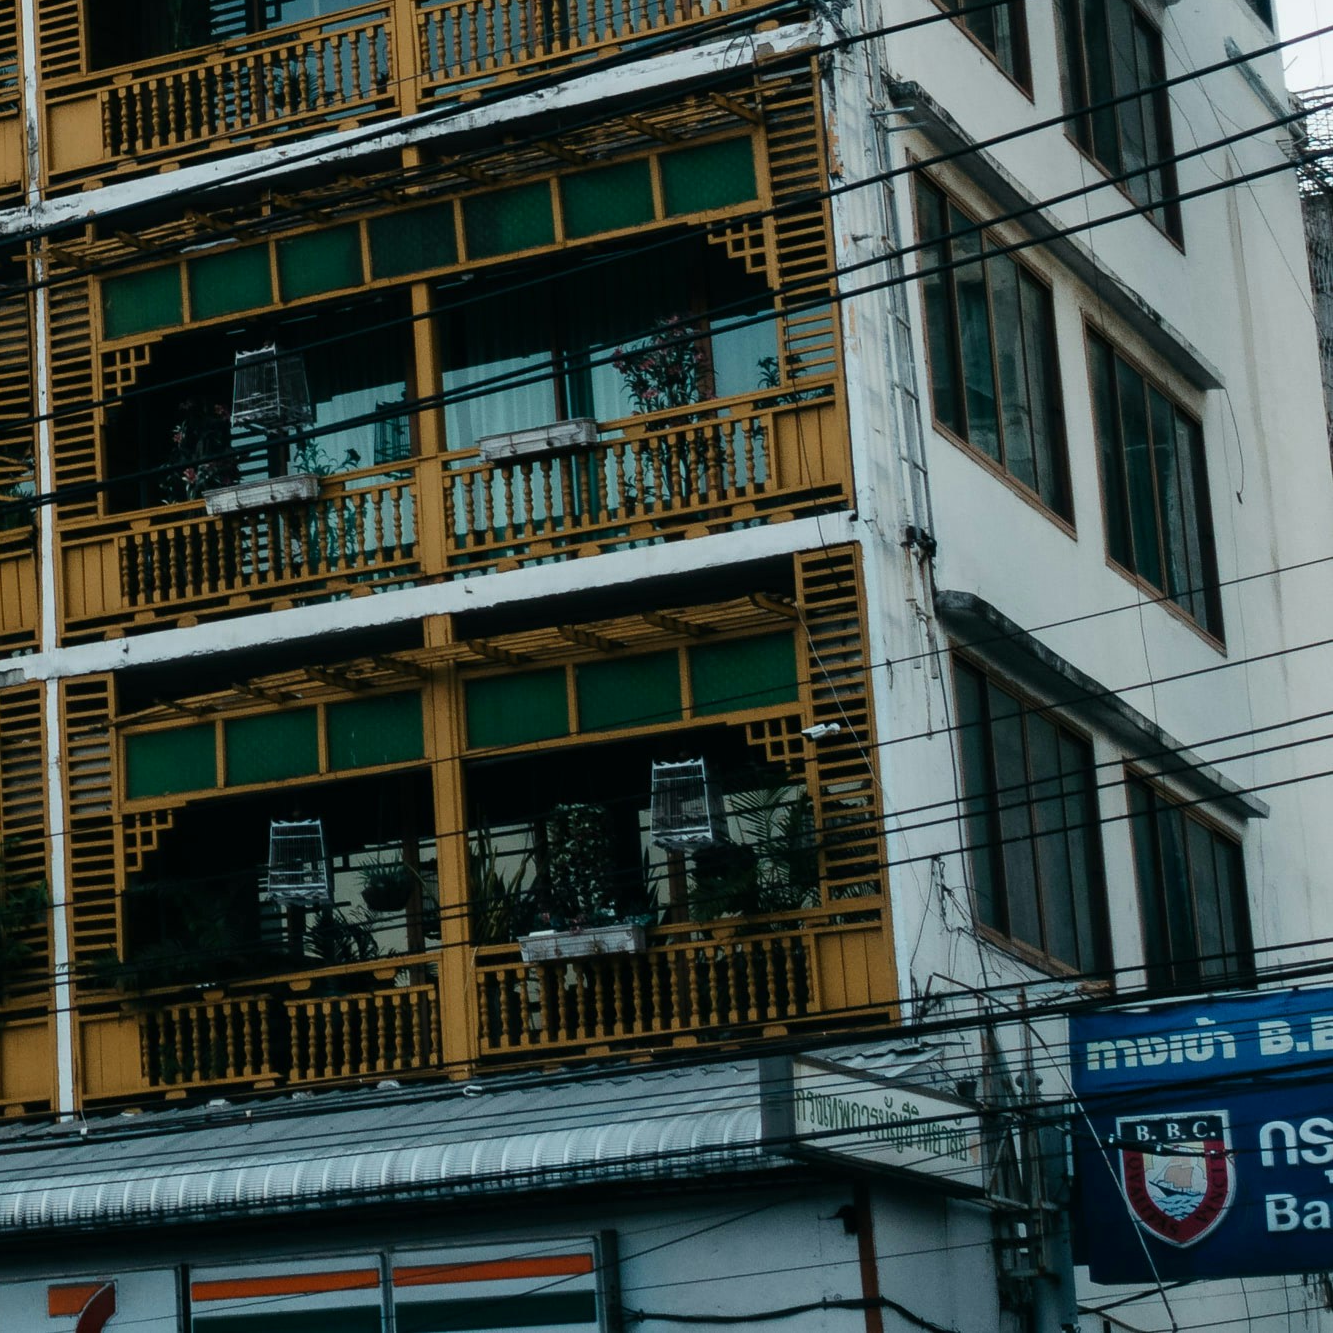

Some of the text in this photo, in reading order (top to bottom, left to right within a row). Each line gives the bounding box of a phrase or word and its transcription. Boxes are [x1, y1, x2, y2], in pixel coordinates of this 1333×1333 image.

[1086, 1017, 1236, 1071] ทางเข้า
[1265, 1193, 1331, 1232] Ba
